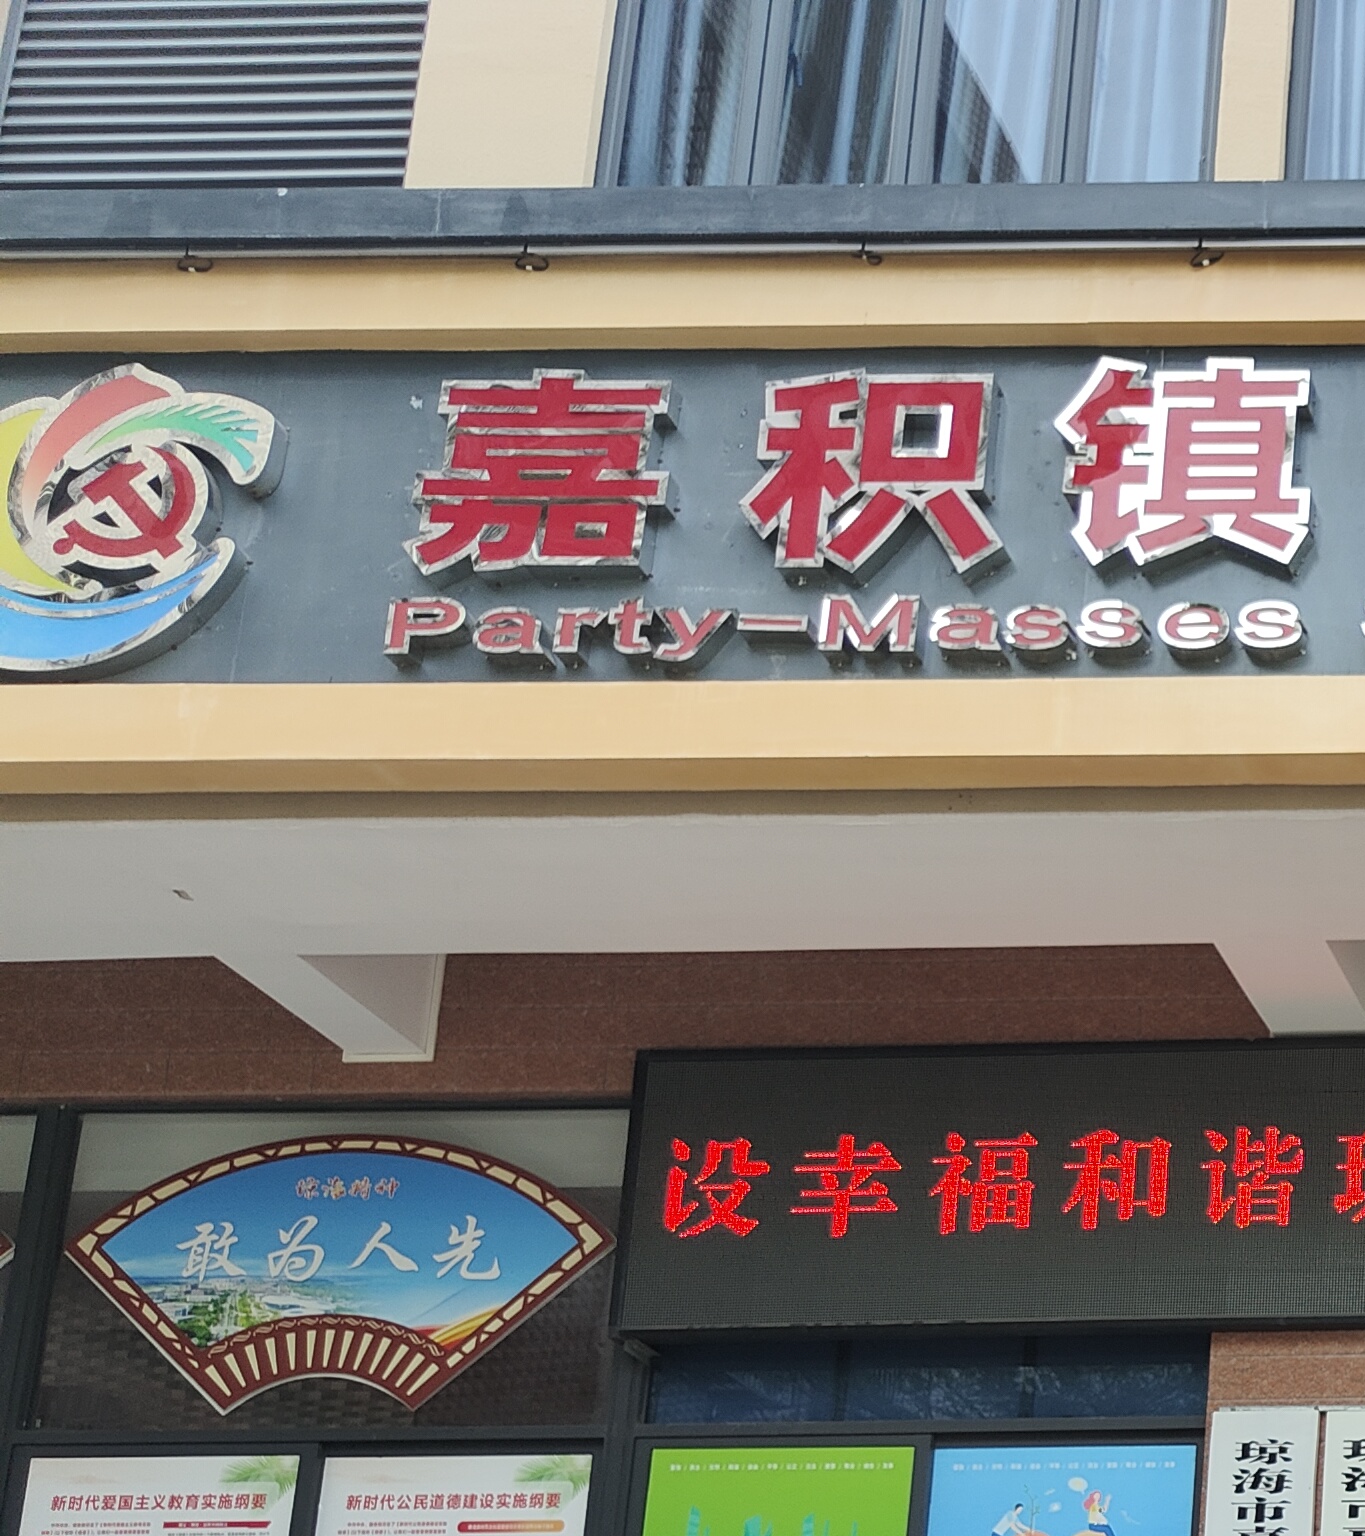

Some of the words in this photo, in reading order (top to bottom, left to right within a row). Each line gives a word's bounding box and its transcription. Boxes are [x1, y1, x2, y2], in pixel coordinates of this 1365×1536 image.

[176, 1215, 502, 1283] 敢为人先
[51, 1493, 268, 1511] 新时代爱国主义教育实施纲要
[346, 1492, 562, 1511] 新时代公民道德建设实施纲要
